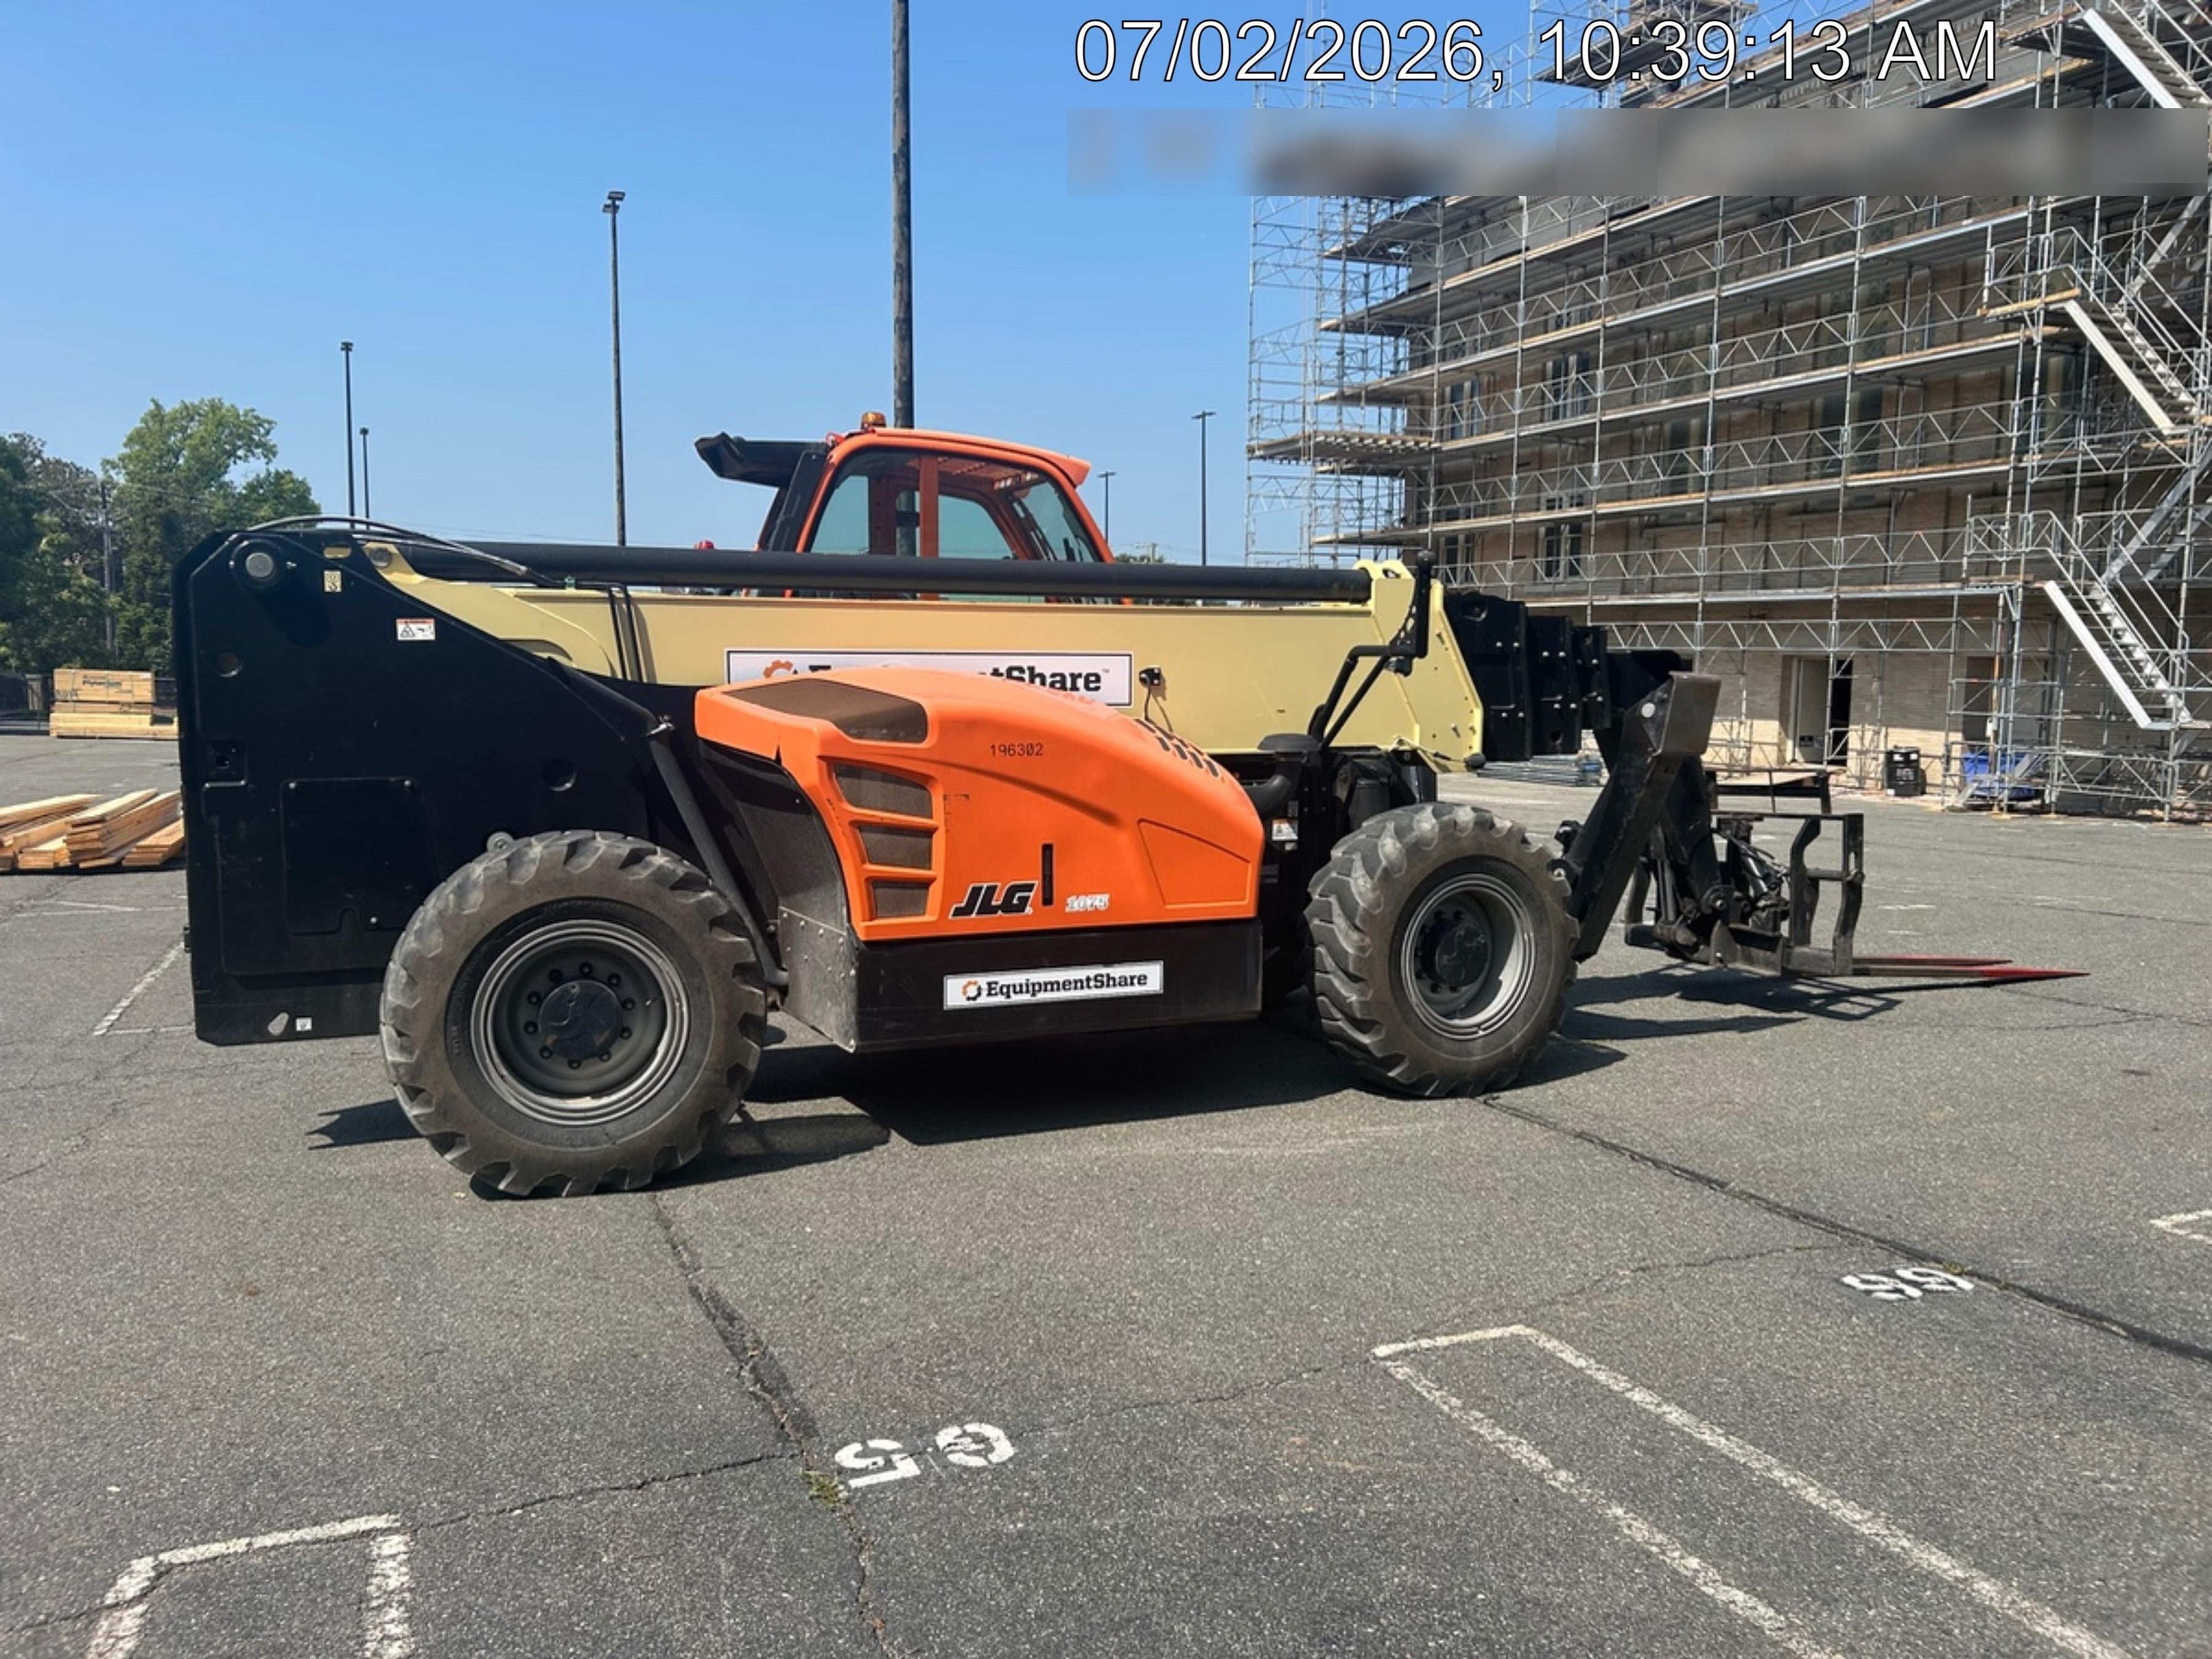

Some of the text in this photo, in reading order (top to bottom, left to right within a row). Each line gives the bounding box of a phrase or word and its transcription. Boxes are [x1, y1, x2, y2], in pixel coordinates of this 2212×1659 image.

[989, 742, 1044, 757] 196302
[949, 880, 1038, 919] JLG
[1065, 893, 1110, 913] 1075
[985, 973, 1148, 999] EquipmentShare
